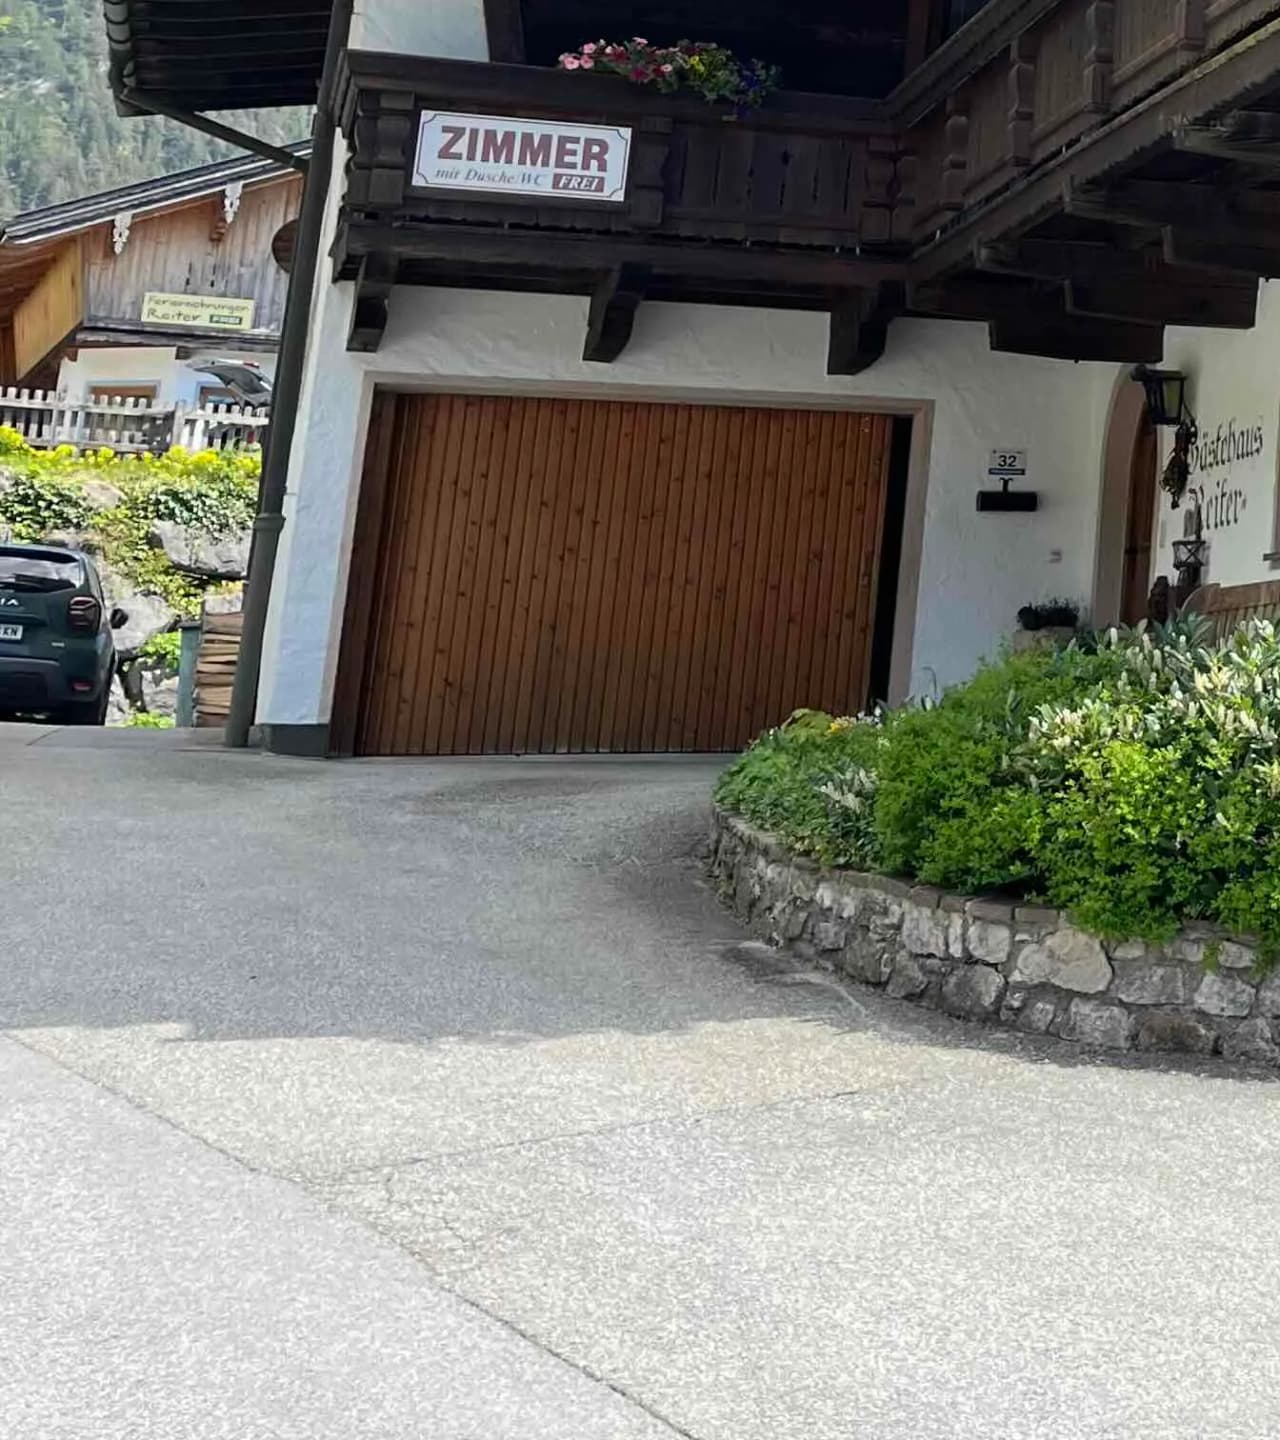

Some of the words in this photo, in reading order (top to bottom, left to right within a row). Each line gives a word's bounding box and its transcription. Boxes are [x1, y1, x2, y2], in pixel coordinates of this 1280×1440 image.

[437, 125, 610, 173] ZIMMER
[434, 167, 462, 180] mit
[558, 175, 600, 192] FREI
[998, 455, 1017, 467] 32
